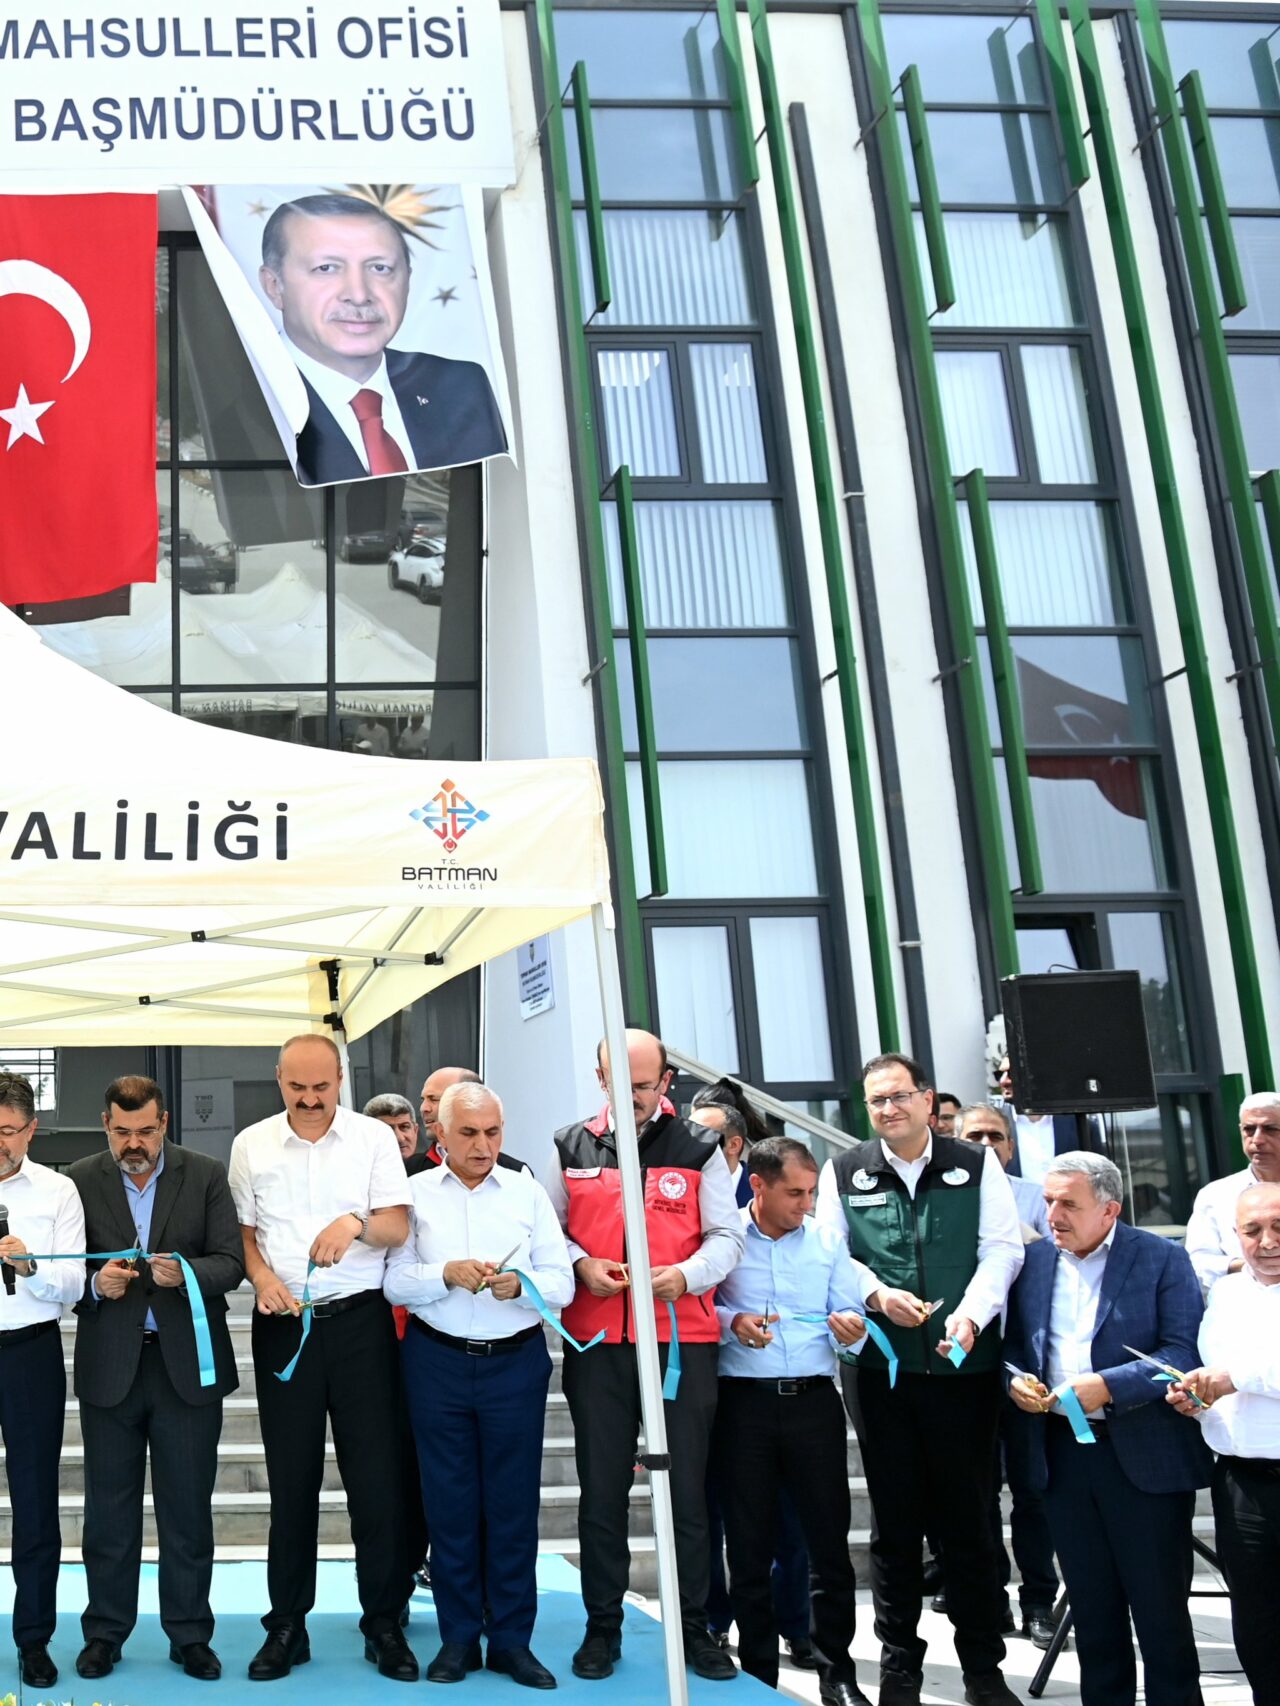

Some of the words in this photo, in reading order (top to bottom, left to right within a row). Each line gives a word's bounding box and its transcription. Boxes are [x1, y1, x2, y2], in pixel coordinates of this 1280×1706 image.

[337, 6, 469, 59] OFİSİ
[14, 85, 475, 153] BAŞMÜDÜRLÜĞÜ
[401, 866, 498, 882] BATMAN
